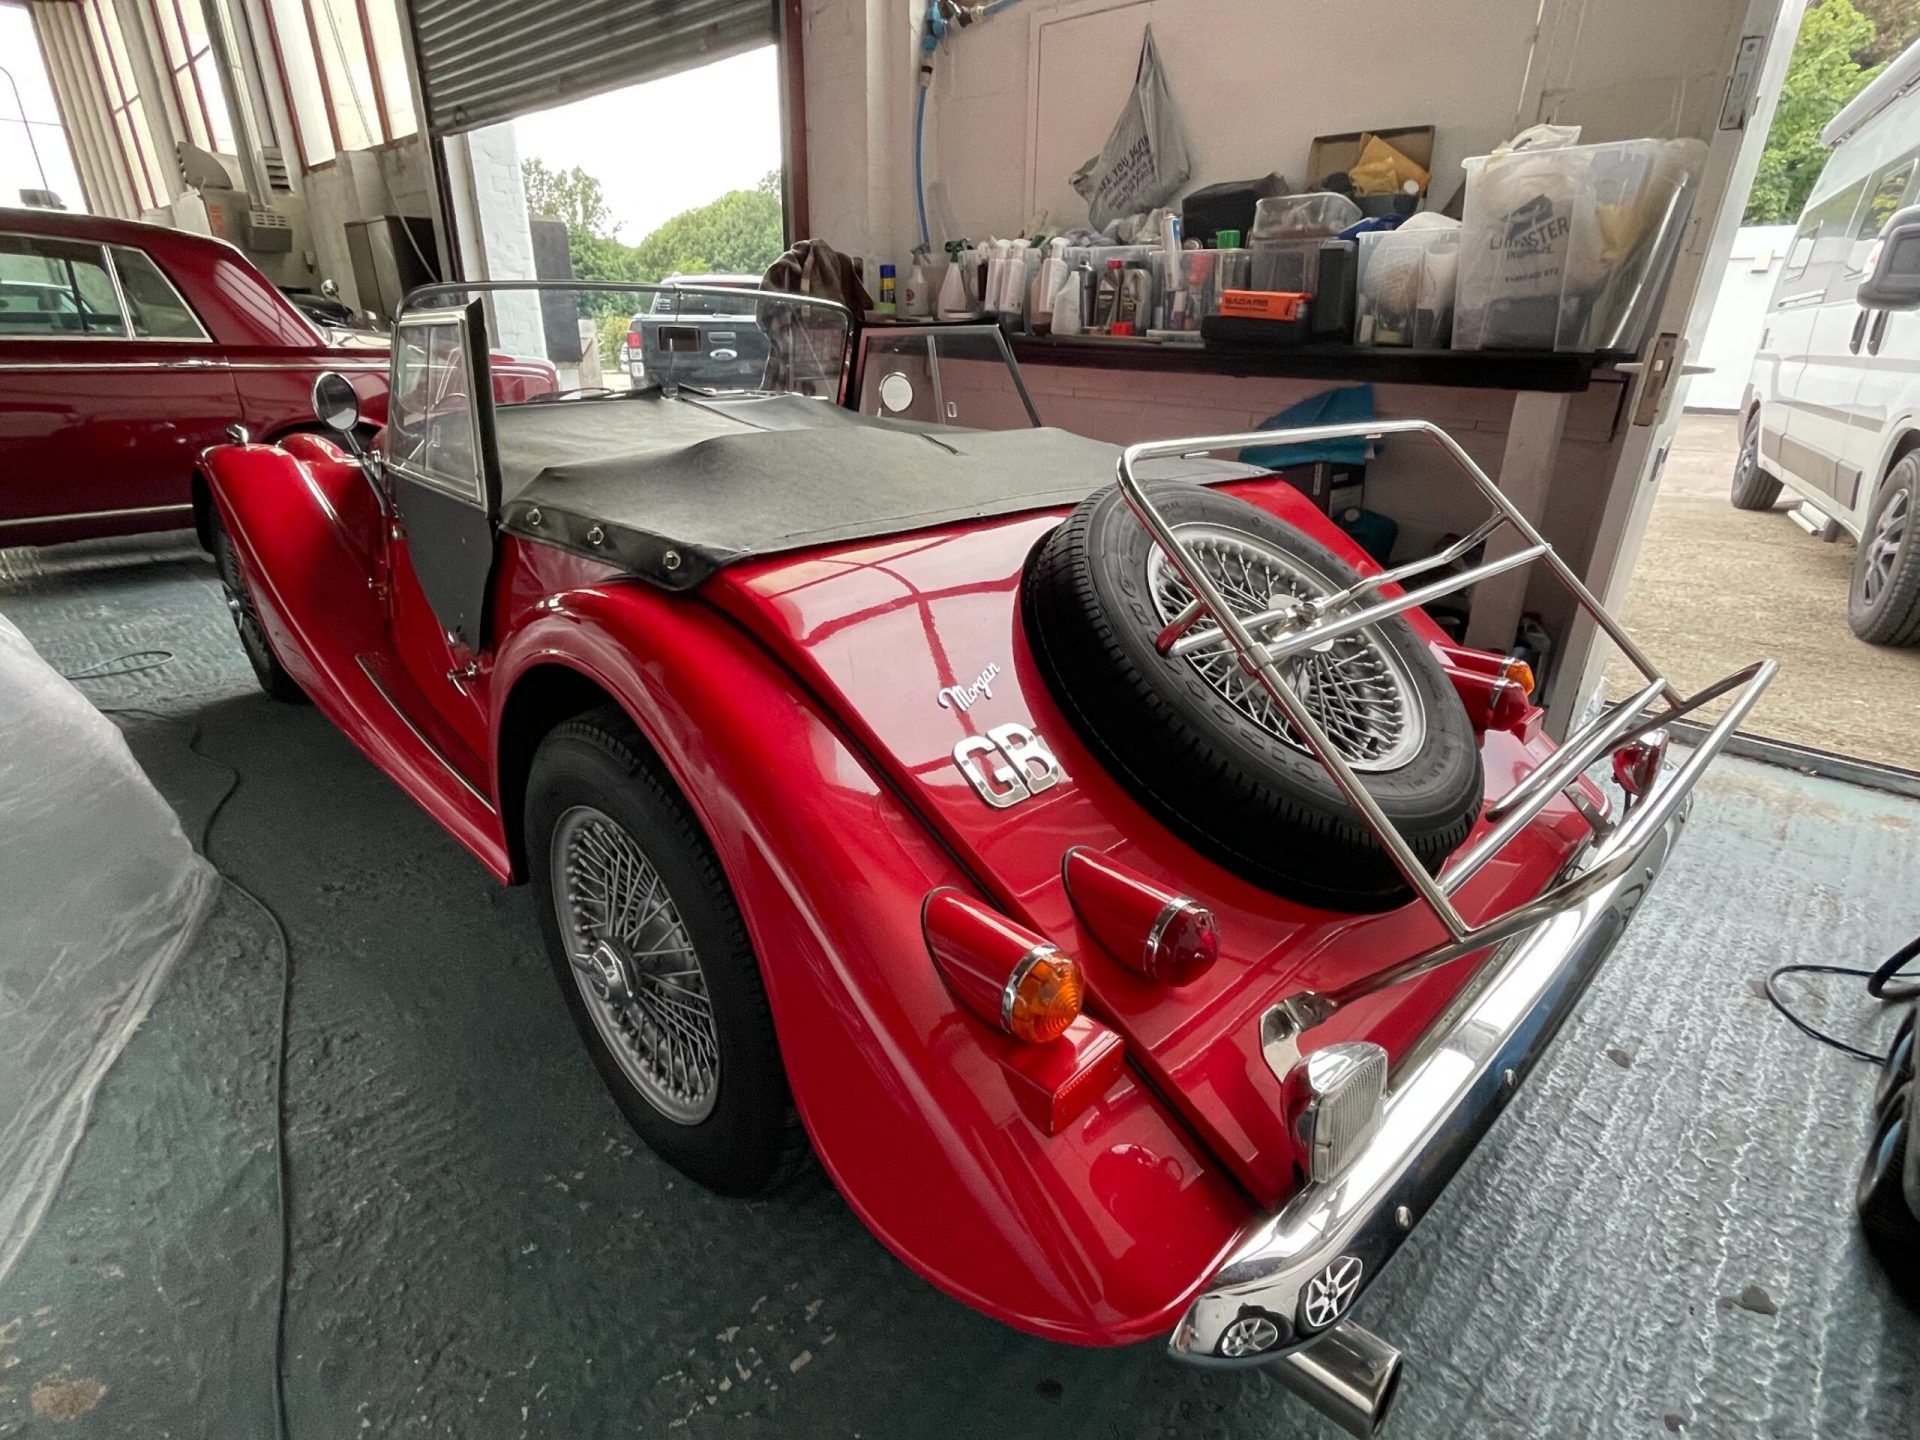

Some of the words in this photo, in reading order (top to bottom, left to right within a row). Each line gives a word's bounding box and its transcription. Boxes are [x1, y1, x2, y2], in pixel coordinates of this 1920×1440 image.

[1111, 155, 1129, 176] YOU
[937, 661, 1001, 712] Morgan
[951, 722, 1060, 809] GB
